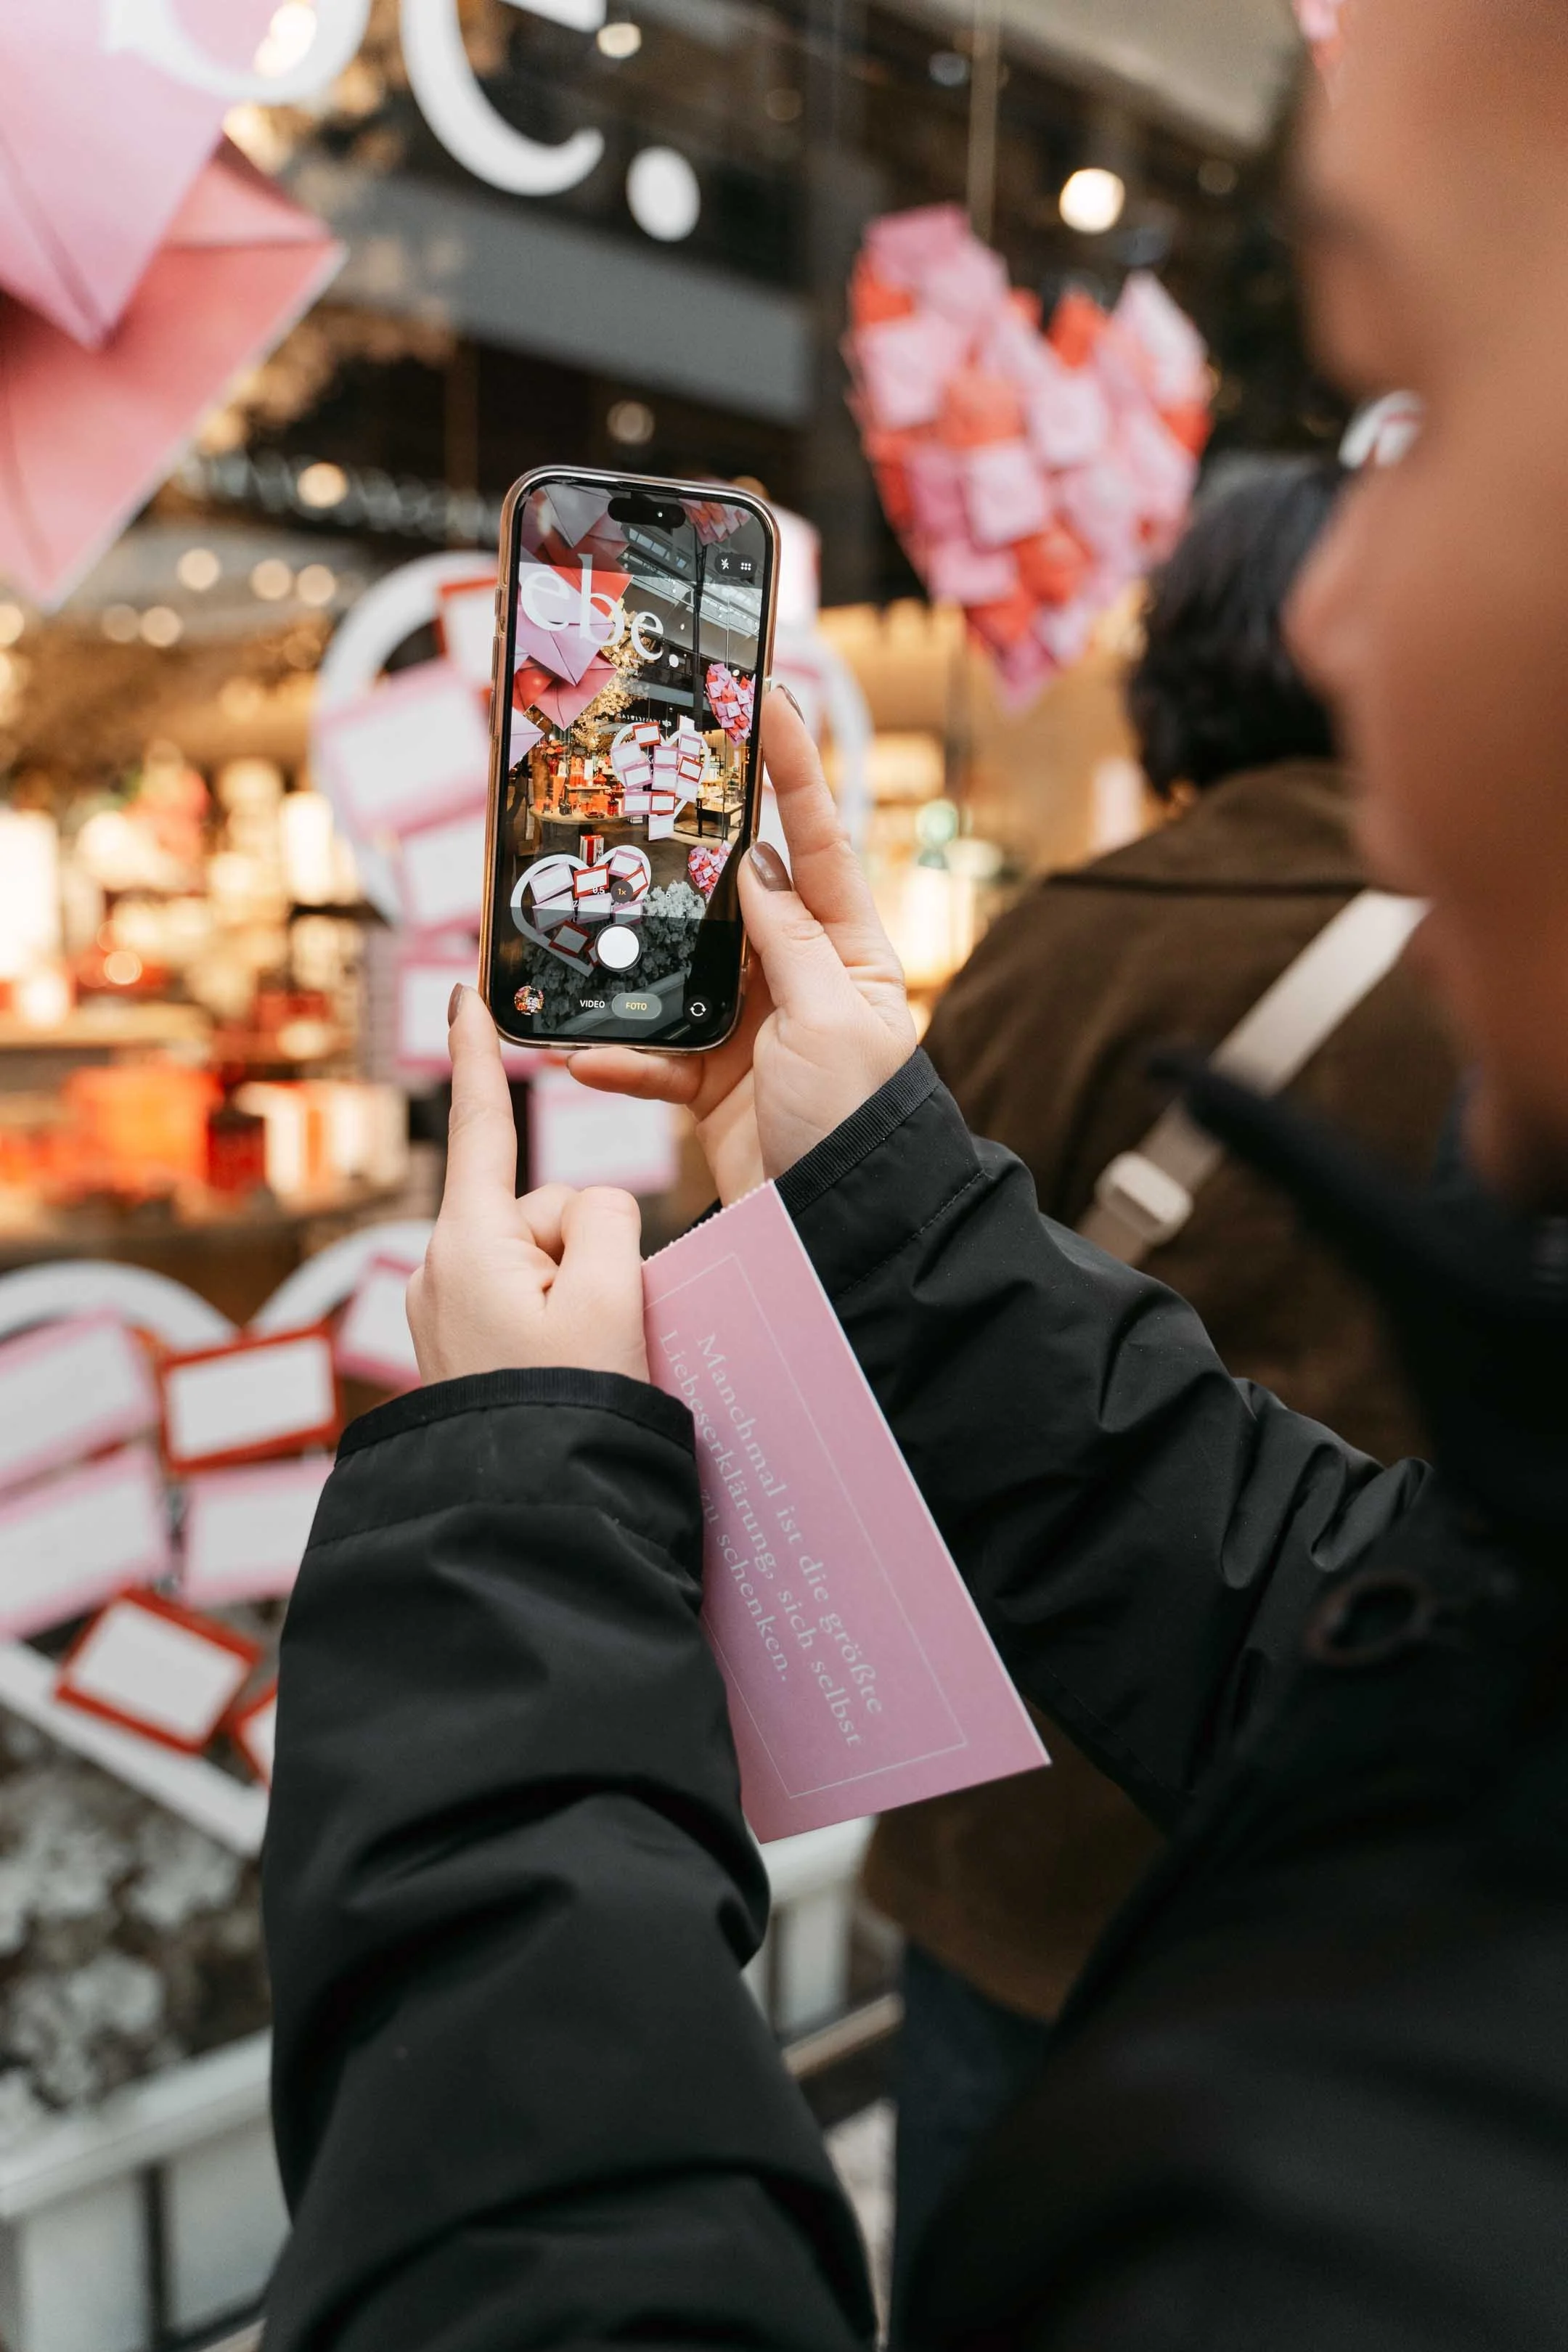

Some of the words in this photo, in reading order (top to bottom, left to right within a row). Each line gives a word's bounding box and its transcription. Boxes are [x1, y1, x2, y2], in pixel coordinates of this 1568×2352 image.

[579, 1000, 605, 1008] VIDEO
[625, 1001, 648, 1011] FOTO
[660, 1329, 775, 1580] Liebeserklärung,
[777, 1590, 813, 1649] sich
[812, 1659, 862, 1748] selbst
[698, 1331, 788, 1498] Manchmal
[776, 1506, 803, 1545] ist
[799, 1553, 830, 1601] die
[818, 1612, 883, 1715] größte
[717, 1533, 789, 1683] schenken.
